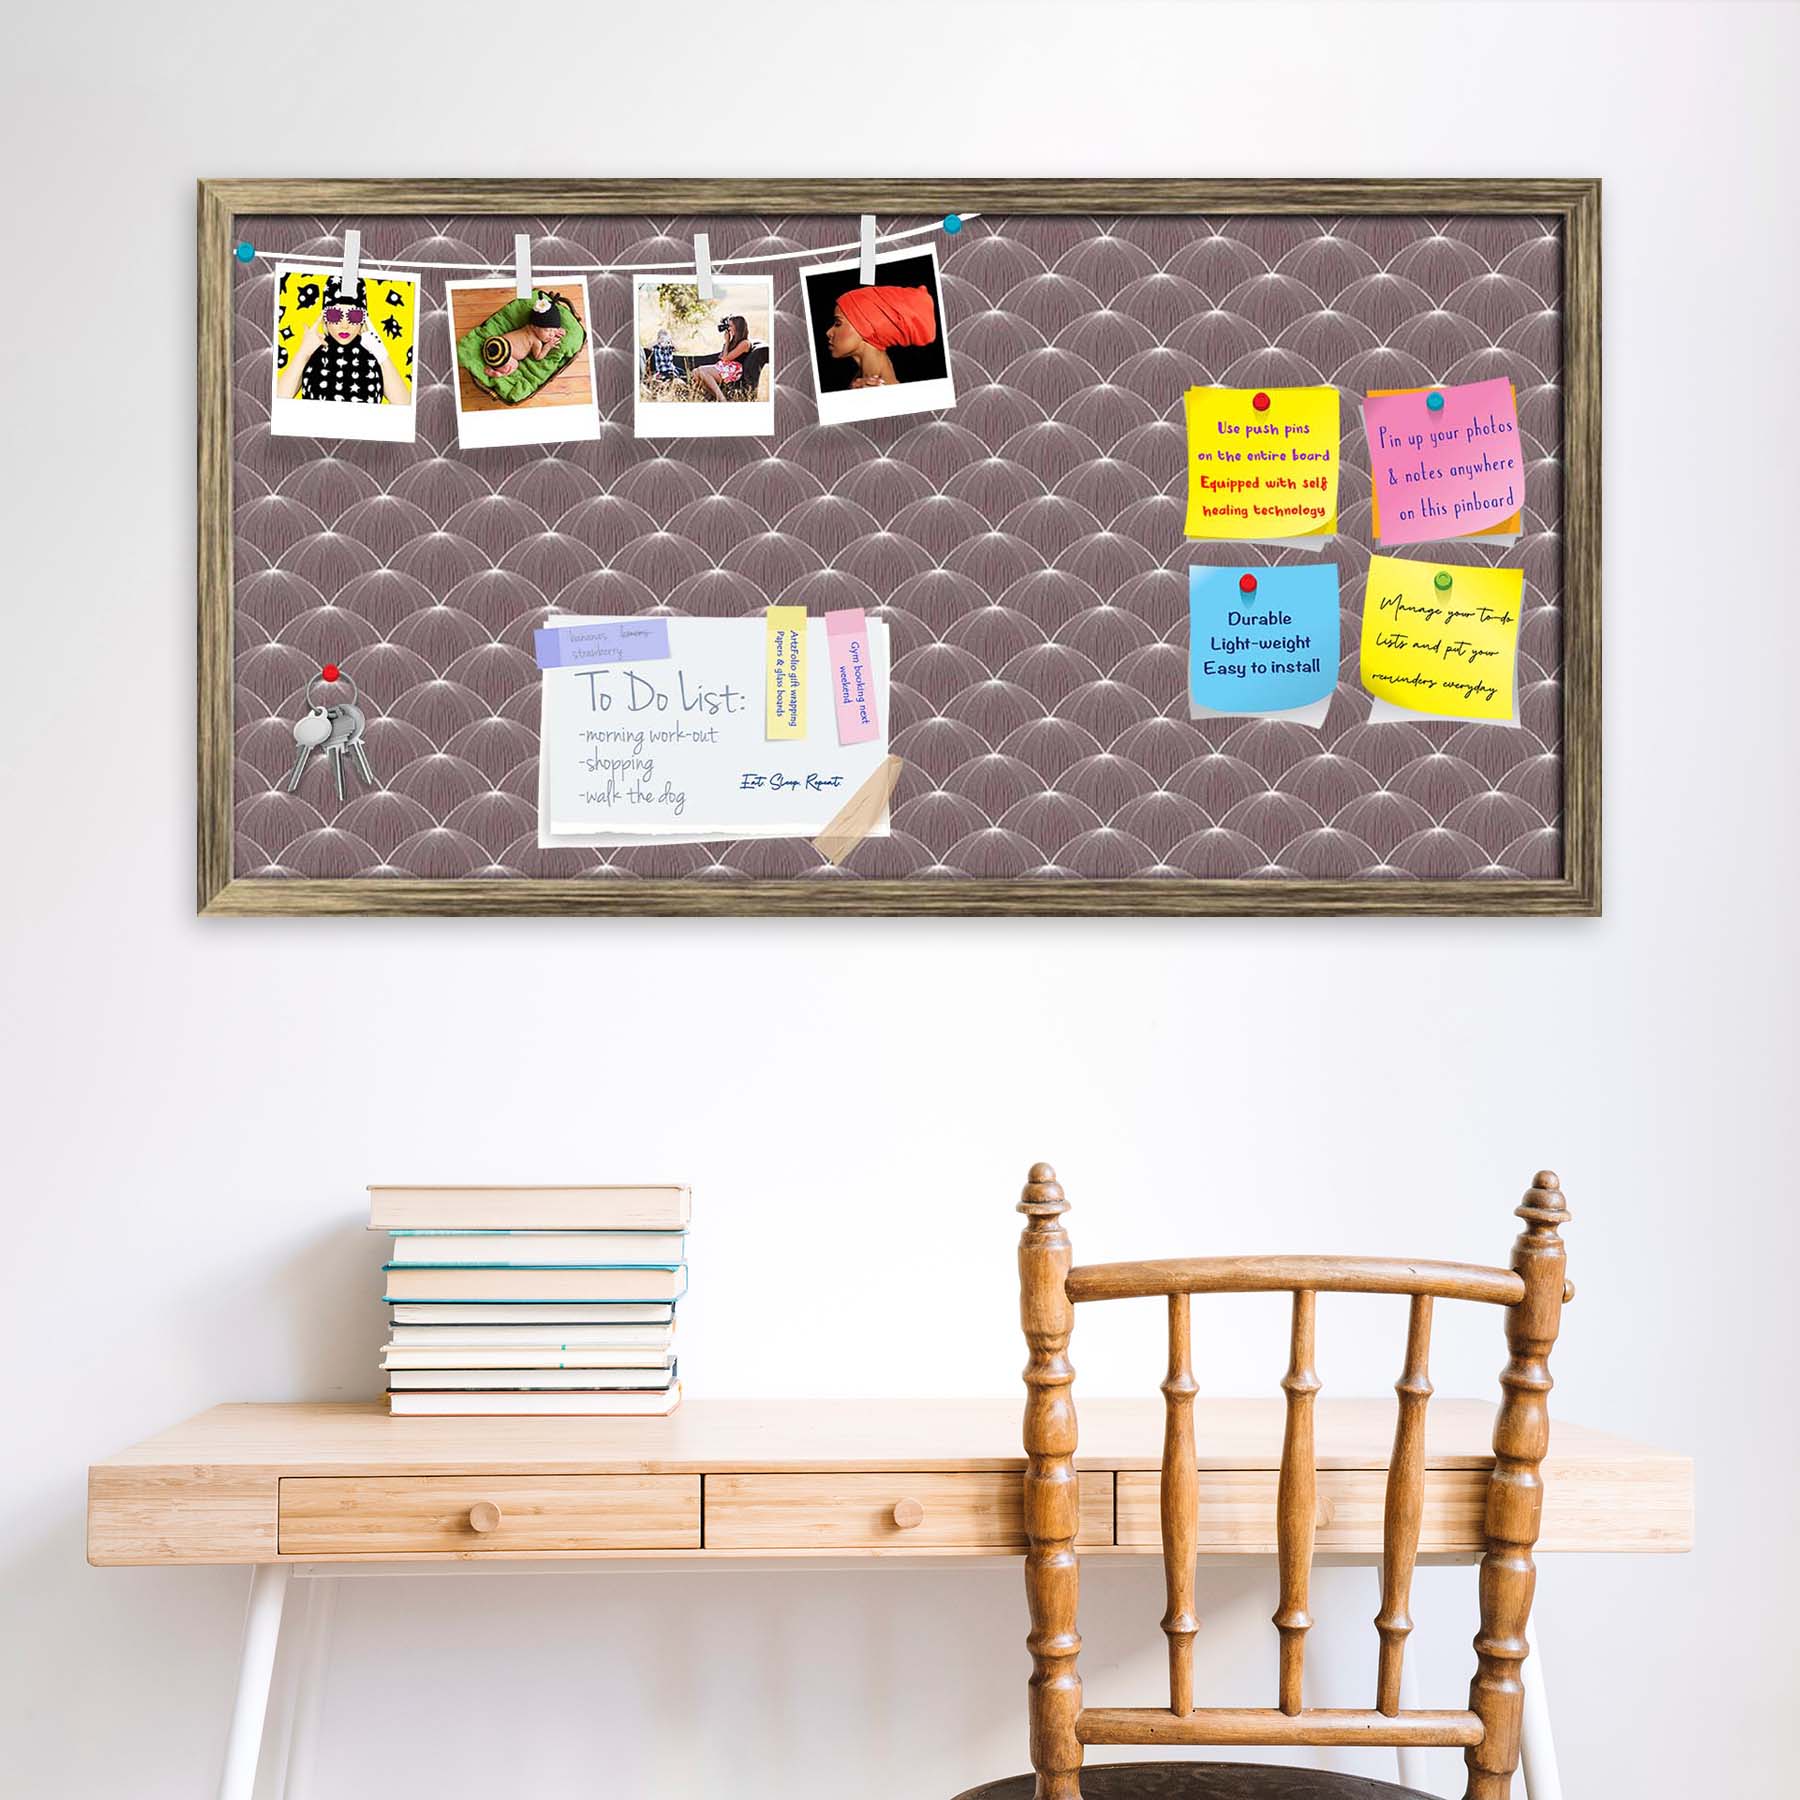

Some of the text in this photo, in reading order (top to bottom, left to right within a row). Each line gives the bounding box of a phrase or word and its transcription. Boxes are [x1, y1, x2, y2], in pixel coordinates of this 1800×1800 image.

[1217, 421, 1310, 438] Use push pins
[1379, 414, 1513, 450] Pin up your photos
[1217, 450, 1241, 462] the
[1247, 450, 1286, 461] entire
[1292, 448, 1330, 461] board
[1388, 452, 1514, 485] & notes anywhere
[1200, 475, 1328, 493] Equipped with self
[1202, 504, 1326, 519] healing technology
[1399, 486, 1514, 520] on this pinboard
[1228, 610, 1292, 626] Durable
[1379, 593, 1442, 622] Manage
[1444, 609, 1475, 624] your
[774, 631, 786, 657] Papers
[1210, 635, 1311, 654] Light-weight
[1412, 639, 1442, 653] and
[1443, 641, 1472, 660] put
[1471, 650, 1499, 663] your
[774, 668, 786, 688] glass
[788, 630, 800, 727] ArtzFolio gift wrapping
[1203, 658, 1321, 679] Easy to install
[574, 670, 746, 715] To Do List:
[839, 665, 853, 704] weekend
[848, 641, 871, 724] Gym booking next
[1371, 672, 1498, 701] reminders everyday
[776, 690, 786, 717] boards
[650, 719, 719, 744] work-out
[626, 778, 655, 804] the
[658, 780, 687, 816] dog
